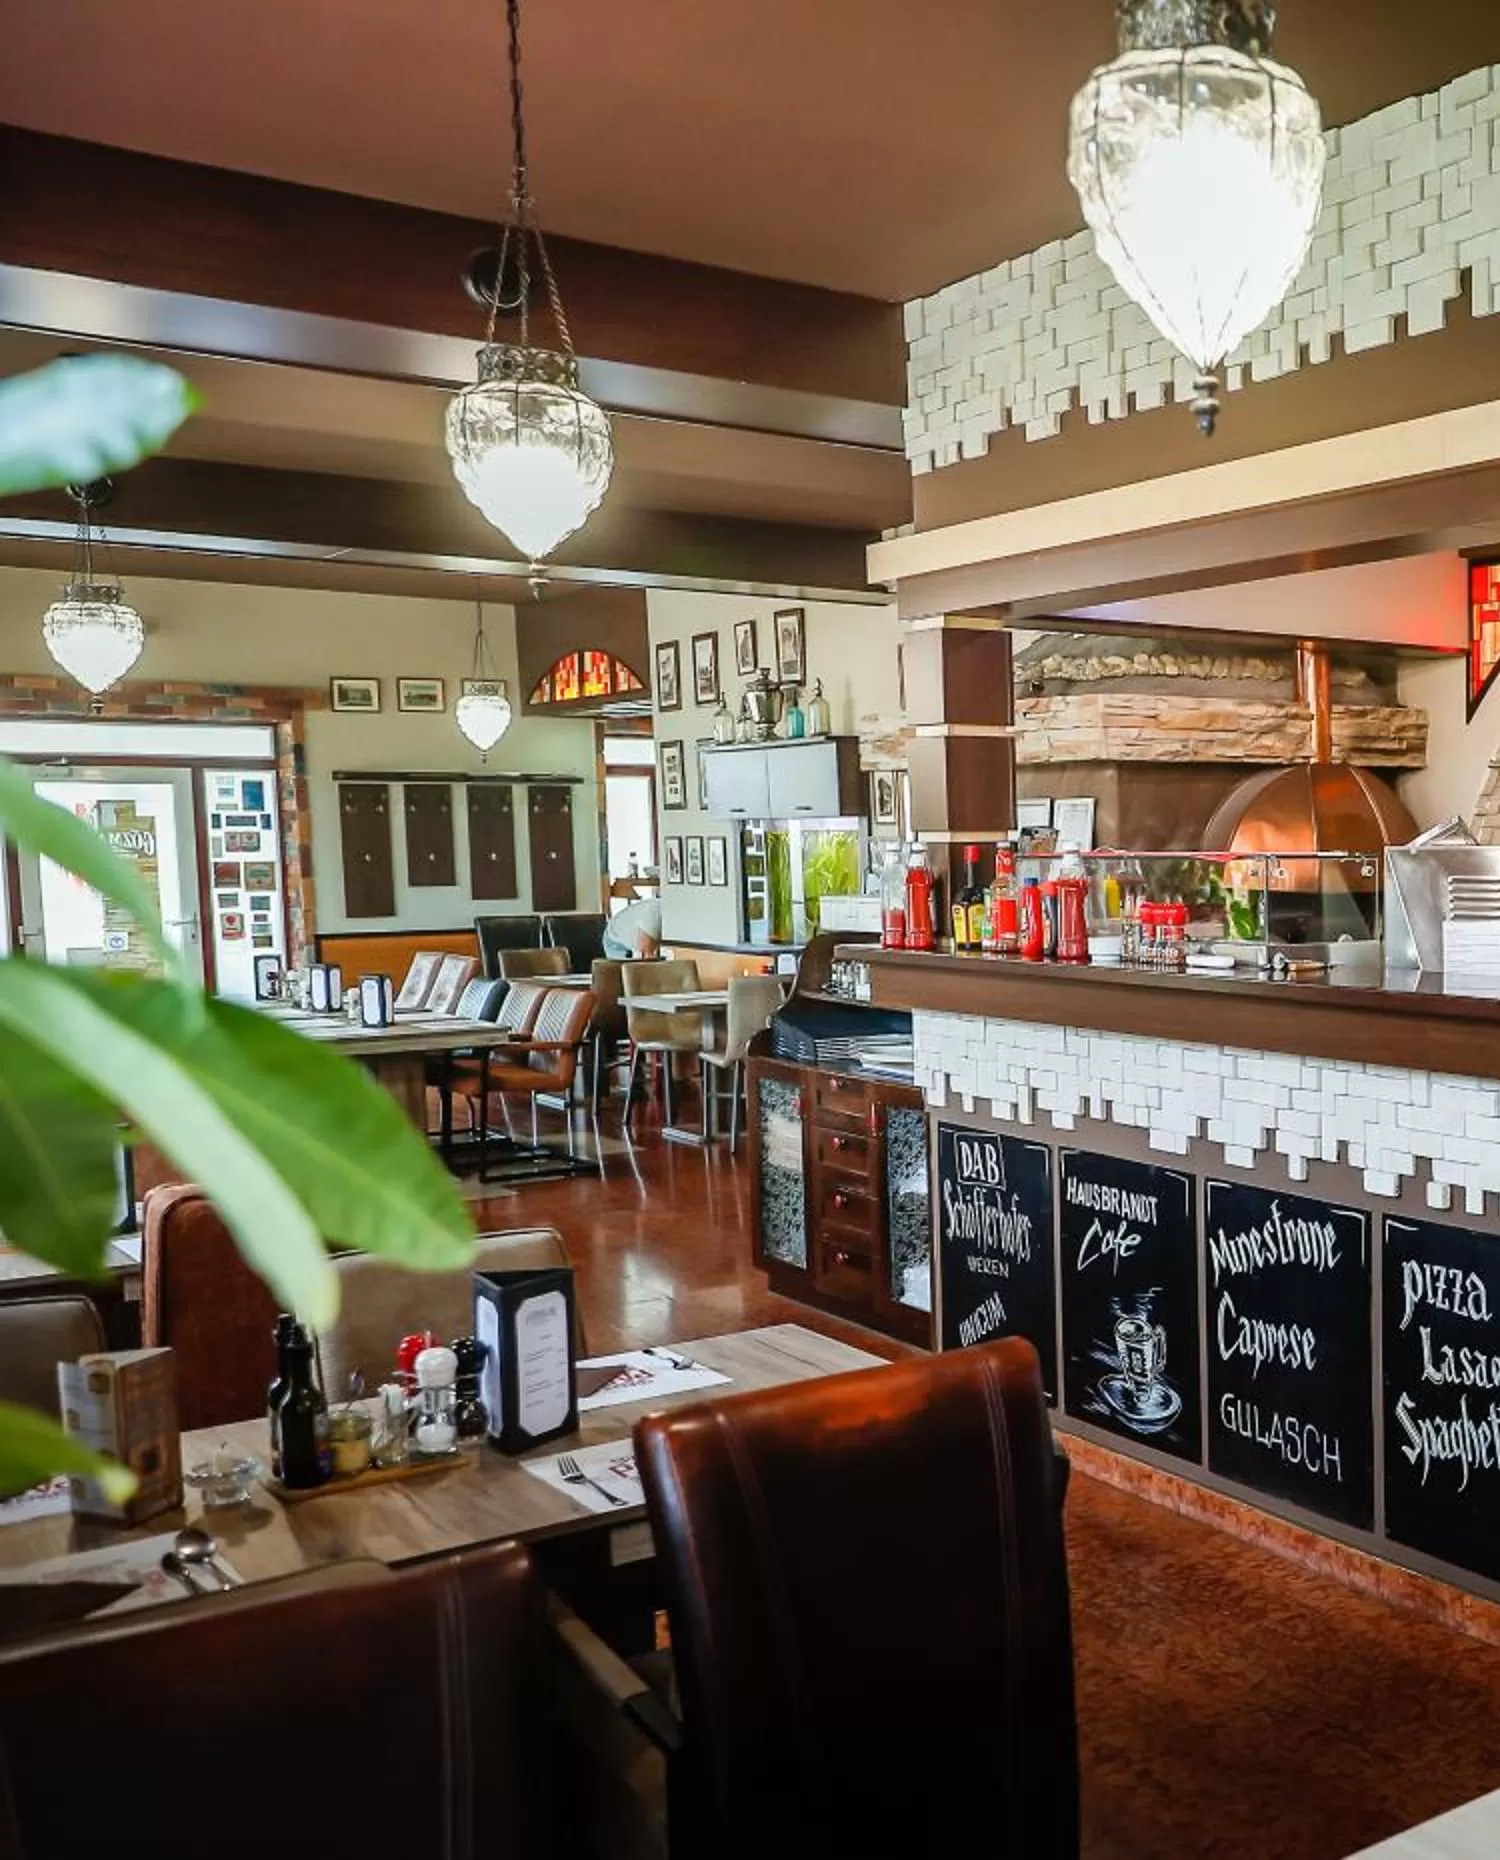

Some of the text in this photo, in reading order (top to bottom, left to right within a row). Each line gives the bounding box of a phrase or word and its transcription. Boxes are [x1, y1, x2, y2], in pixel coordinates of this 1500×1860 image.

[959, 1141, 1000, 1184] DAB
[1067, 1176, 1158, 1226] HAUSBRANDT
[1077, 1217, 1142, 1276] Cafe
[1209, 1200, 1342, 1288] Minestrone
[1217, 1290, 1316, 1380] Caprese
[1220, 1393, 1342, 1482] GULASCH
